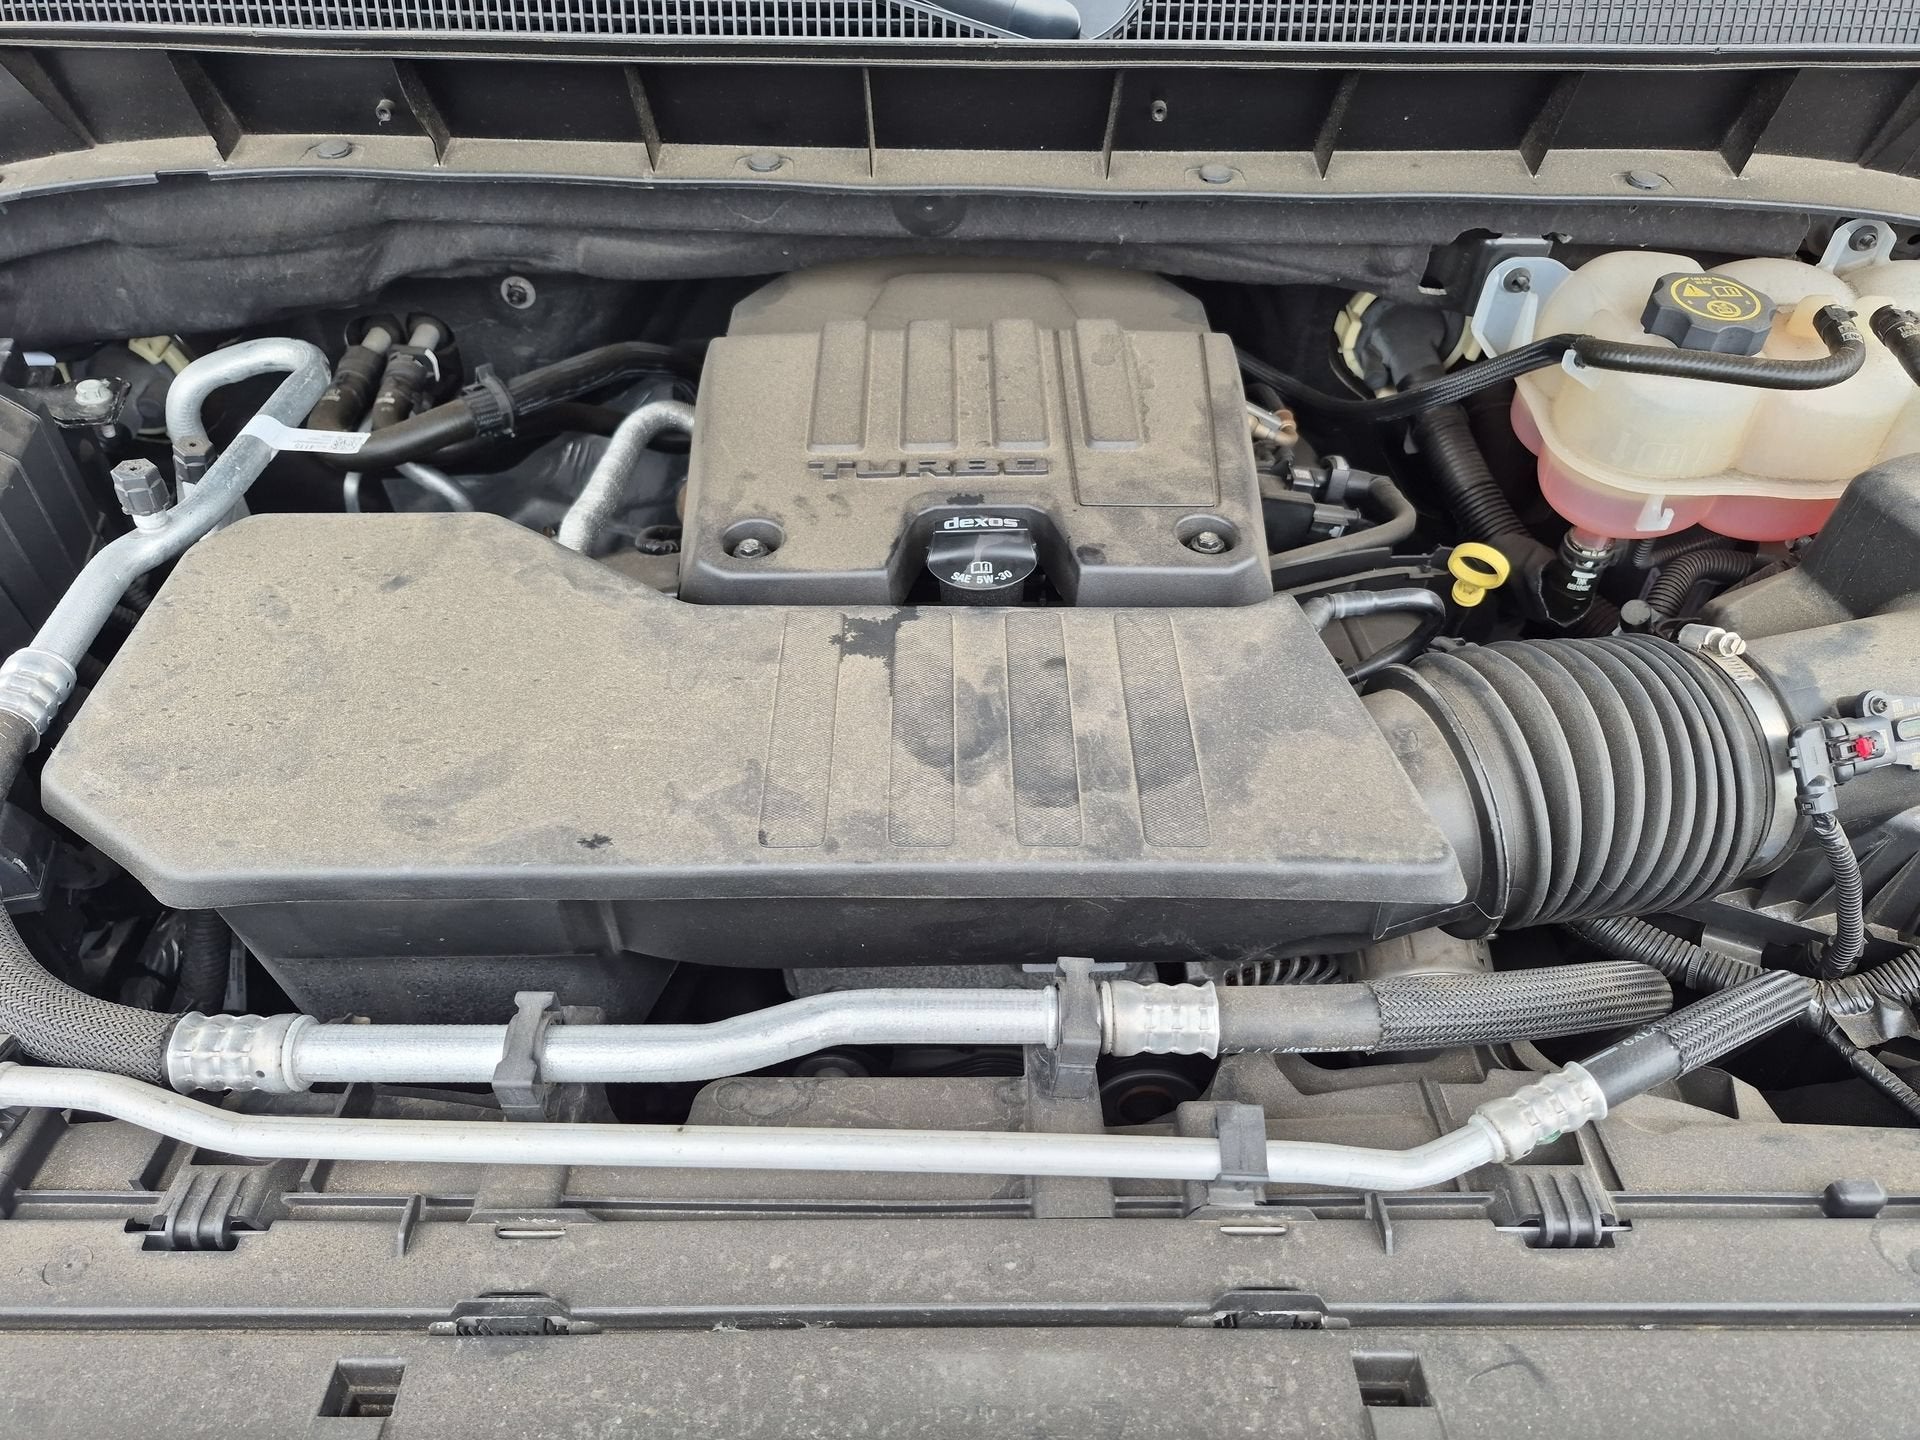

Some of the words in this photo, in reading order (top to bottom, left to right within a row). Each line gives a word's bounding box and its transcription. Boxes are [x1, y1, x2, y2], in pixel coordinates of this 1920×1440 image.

[808, 458, 1049, 480] TURBO
[943, 516, 1019, 530] dexos
[950, 571, 972, 584] SAE
[976, 569, 1013, 584] 5W-30
[1622, 1023, 1664, 1046] GALA
